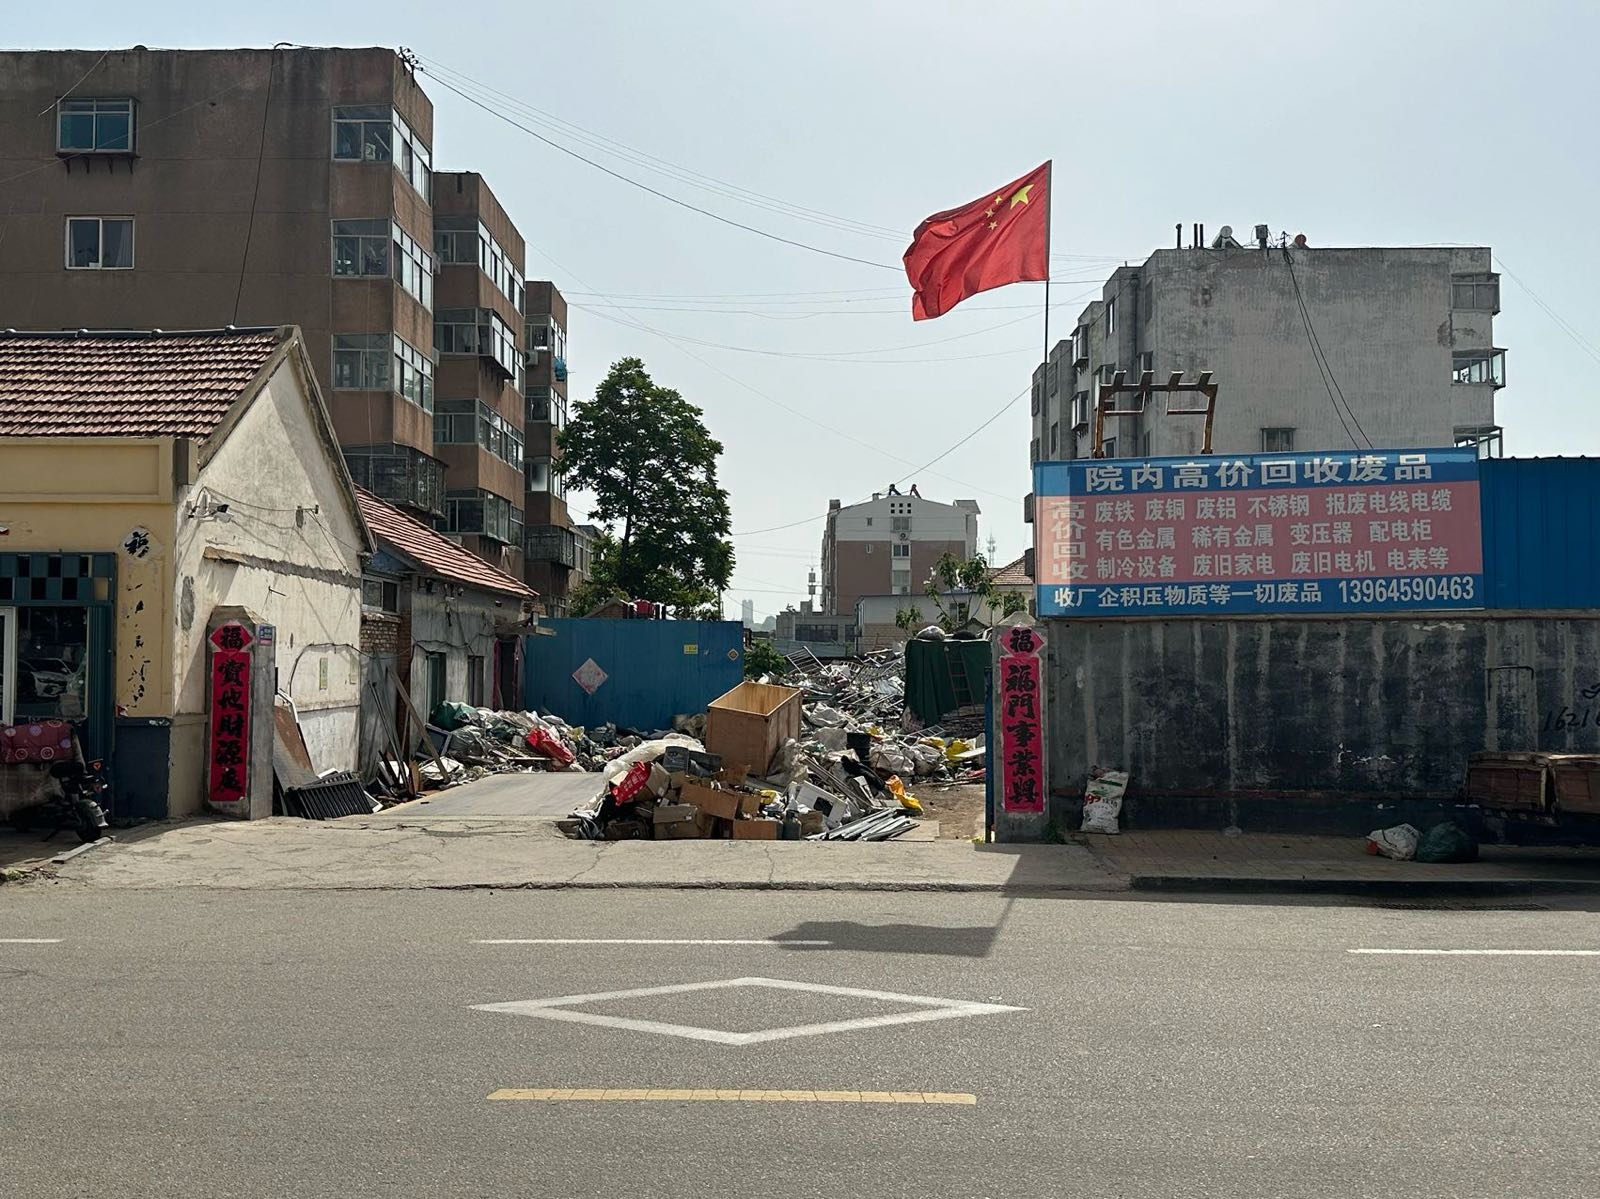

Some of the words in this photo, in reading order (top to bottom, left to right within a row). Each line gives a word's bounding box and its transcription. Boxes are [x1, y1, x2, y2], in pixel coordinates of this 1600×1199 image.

[1085, 454, 1432, 492] 院内高价回收废品
[1094, 500, 1135, 523] 废铁
[1145, 498, 1185, 521] 废铜
[1196, 496, 1236, 520] 废铝
[1247, 494, 1310, 518] 不锈钢
[1325, 489, 1452, 515] 报废电线电缆
[1050, 501, 1089, 579] 高价回收
[1096, 527, 1176, 551] 有色金属
[1191, 523, 1274, 548] 稀有金属
[1290, 522, 1353, 545] 变压器
[1368, 519, 1433, 543] 配电柜
[1096, 555, 1177, 579] 制冷设备
[1192, 553, 1275, 577] 废旧家电
[1290, 550, 1376, 574] 废旧电机
[1387, 546, 1449, 571] 电表等
[1054, 582, 1322, 608] 收厂企积压物质等一切废品
[1338, 576, 1474, 604] 13964590463
[222, 626, 243, 649] 福
[1010, 629, 1034, 653] 福
